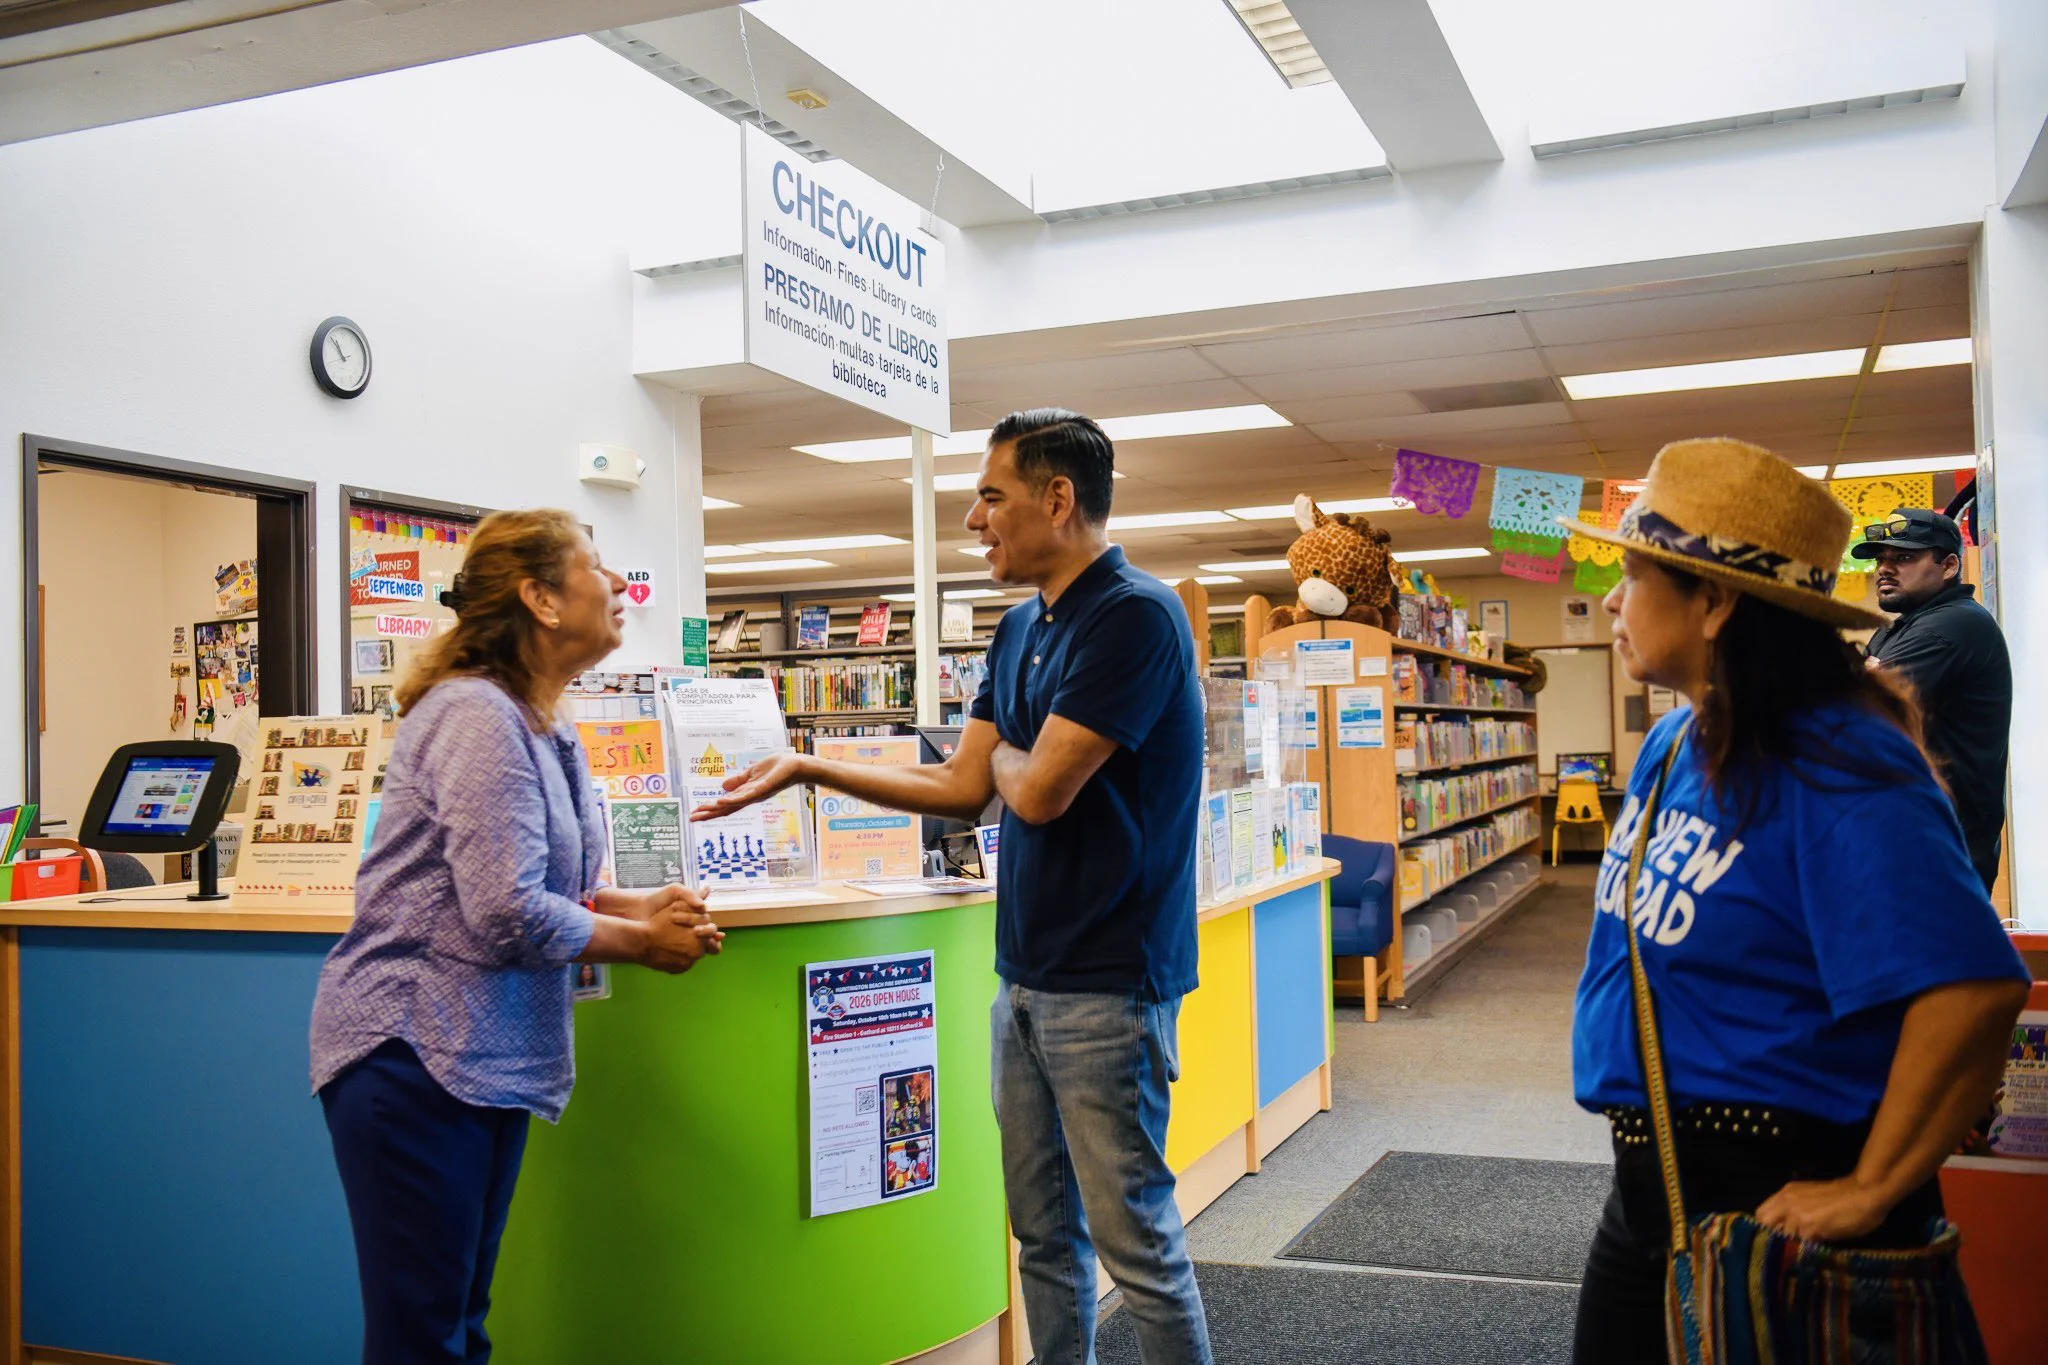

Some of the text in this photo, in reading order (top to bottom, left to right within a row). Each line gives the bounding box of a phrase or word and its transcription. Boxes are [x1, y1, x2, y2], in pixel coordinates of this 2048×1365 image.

[772, 160, 927, 287] CHECKOUT
[763, 221, 937, 328] Information Fines Library cards
[764, 262, 939, 369] PRESTAMO DE LIBROS
[765, 300, 940, 394] Información multas tarjeta de la
[832, 359, 887, 398] biblioteca
[627, 571, 650, 582] AED
[369, 578, 423, 598] SEPTEMBER
[377, 617, 431, 637] LIBRARY
[863, 615, 885, 625] JILLS
[867, 819, 894, 827] October
[1646, 808, 1744, 895] VIEW
[849, 988, 920, 1009] 2026 OPEN HOUSE
[845, 1120, 870, 1129] ALLOWED
